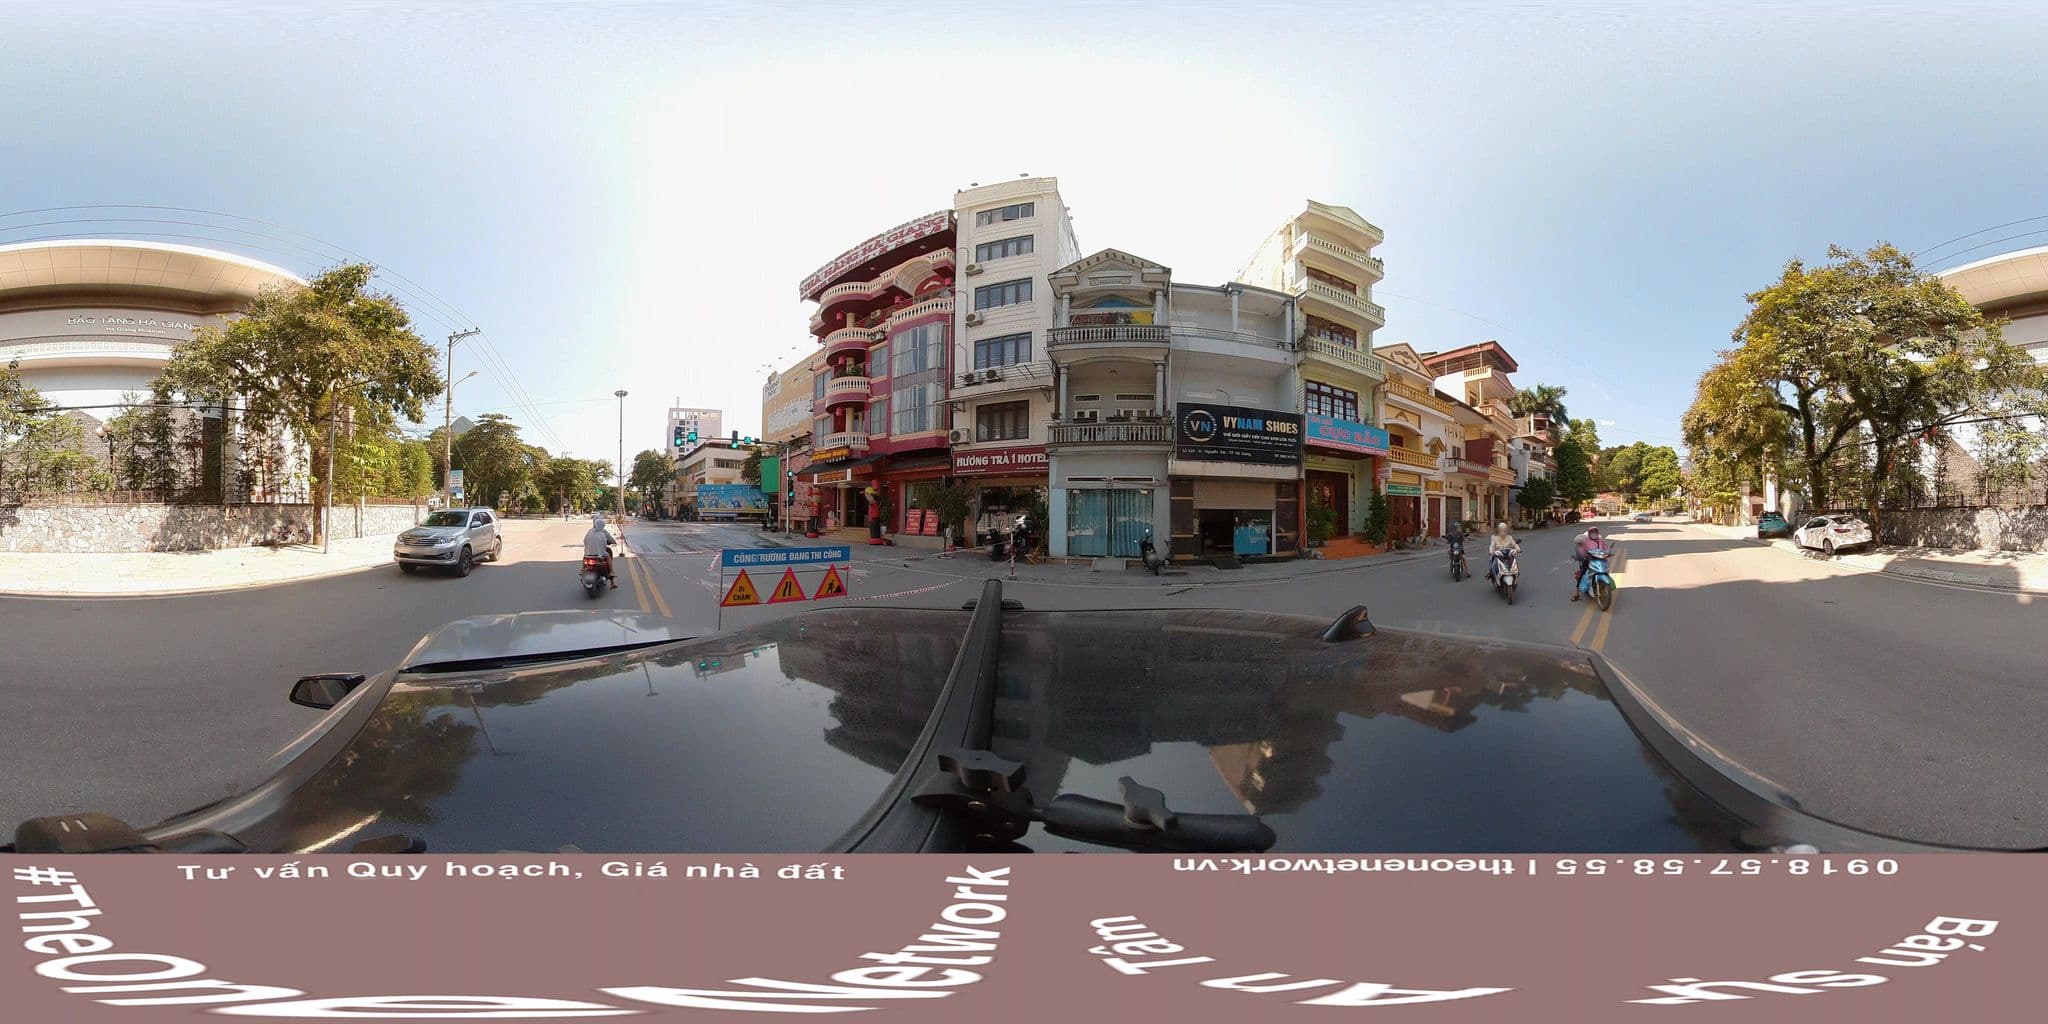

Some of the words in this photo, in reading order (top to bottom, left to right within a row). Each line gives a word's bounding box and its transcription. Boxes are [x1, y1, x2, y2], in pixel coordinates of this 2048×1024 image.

[886, 215, 946, 243] GIANG
[100, 315, 135, 326] TÀNG
[138, 317, 158, 327] HÀ
[1190, 420, 1212, 433] VN
[1223, 415, 1264, 432] VYNAM
[1266, 420, 1299, 435] SHOES
[1320, 425, 1351, 441] CỤC
[956, 454, 989, 467] HƯƠNG
[990, 451, 1010, 465] TRÀ
[1011, 453, 1016, 464] 1
[1017, 453, 1050, 464] HOTEL
[733, 552, 757, 563] CÔNG
[789, 551, 810, 561] ĐANG
[810, 551, 822, 560] THI
[823, 548, 842, 559] CÔNG
